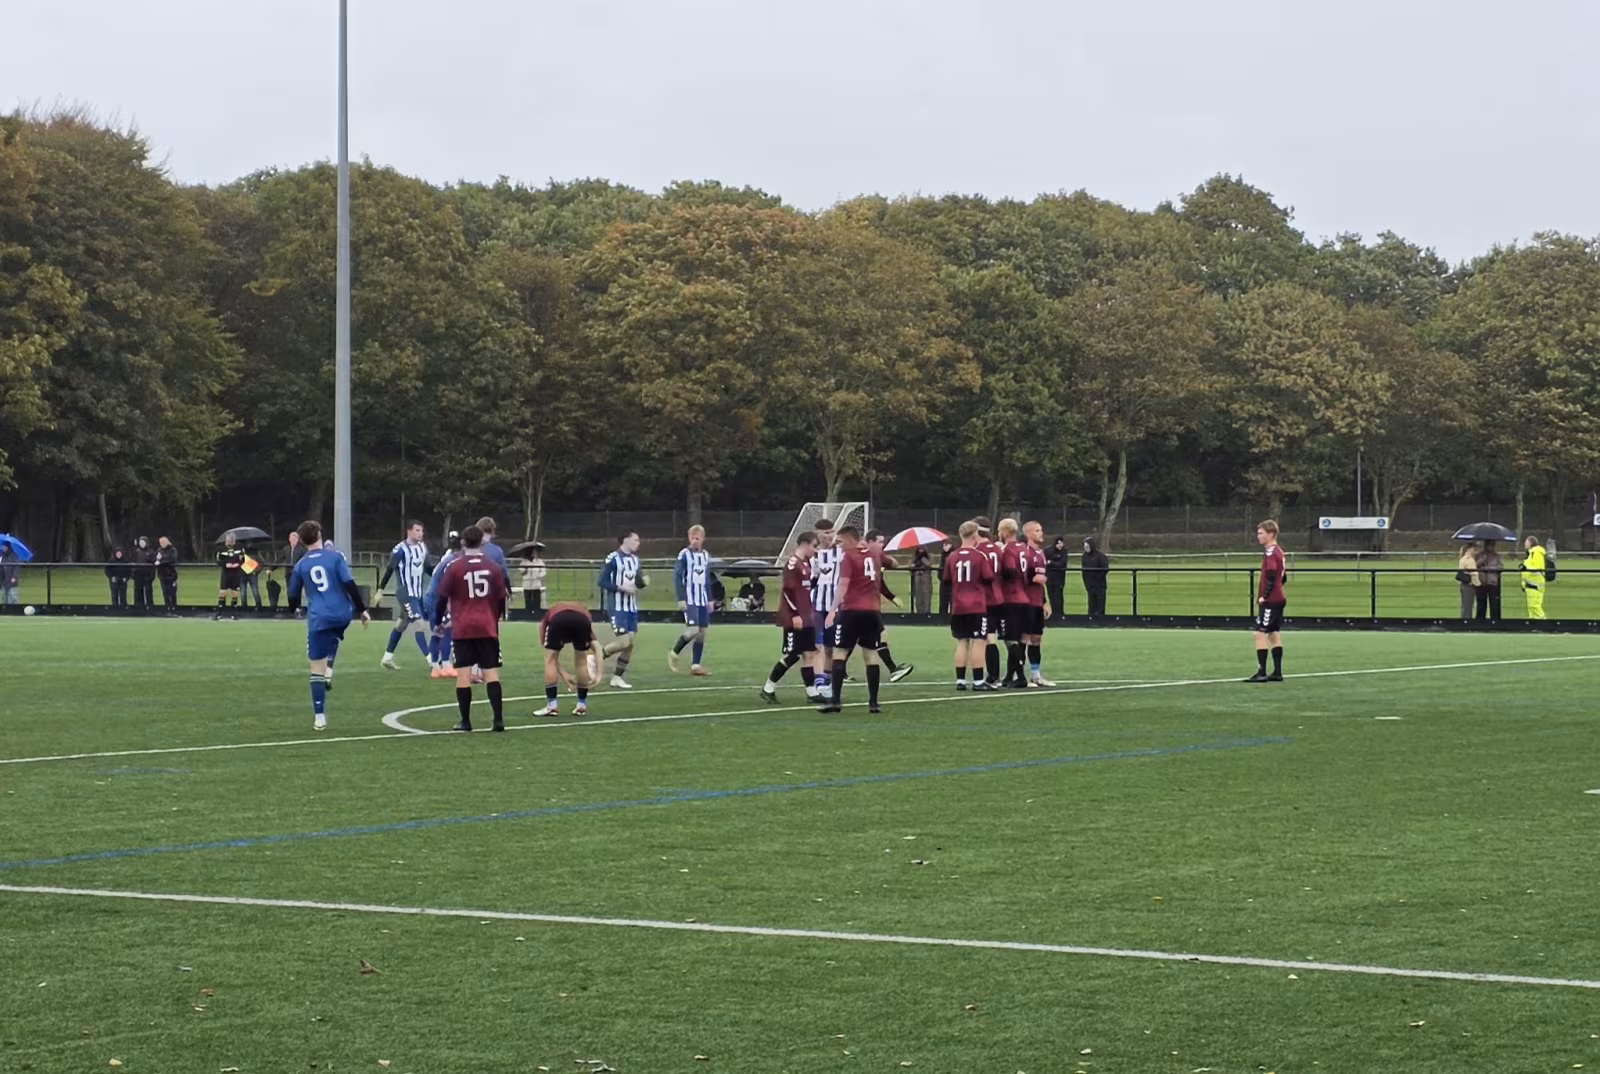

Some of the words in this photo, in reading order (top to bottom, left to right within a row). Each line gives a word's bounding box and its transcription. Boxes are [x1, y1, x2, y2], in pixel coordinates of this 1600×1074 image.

[864, 557, 876, 581] 4
[956, 560, 971, 583] 11
[989, 552, 998, 573] 7
[1019, 551, 1028, 572] 6
[310, 565, 329, 593] 9
[463, 569, 490, 598] 15
